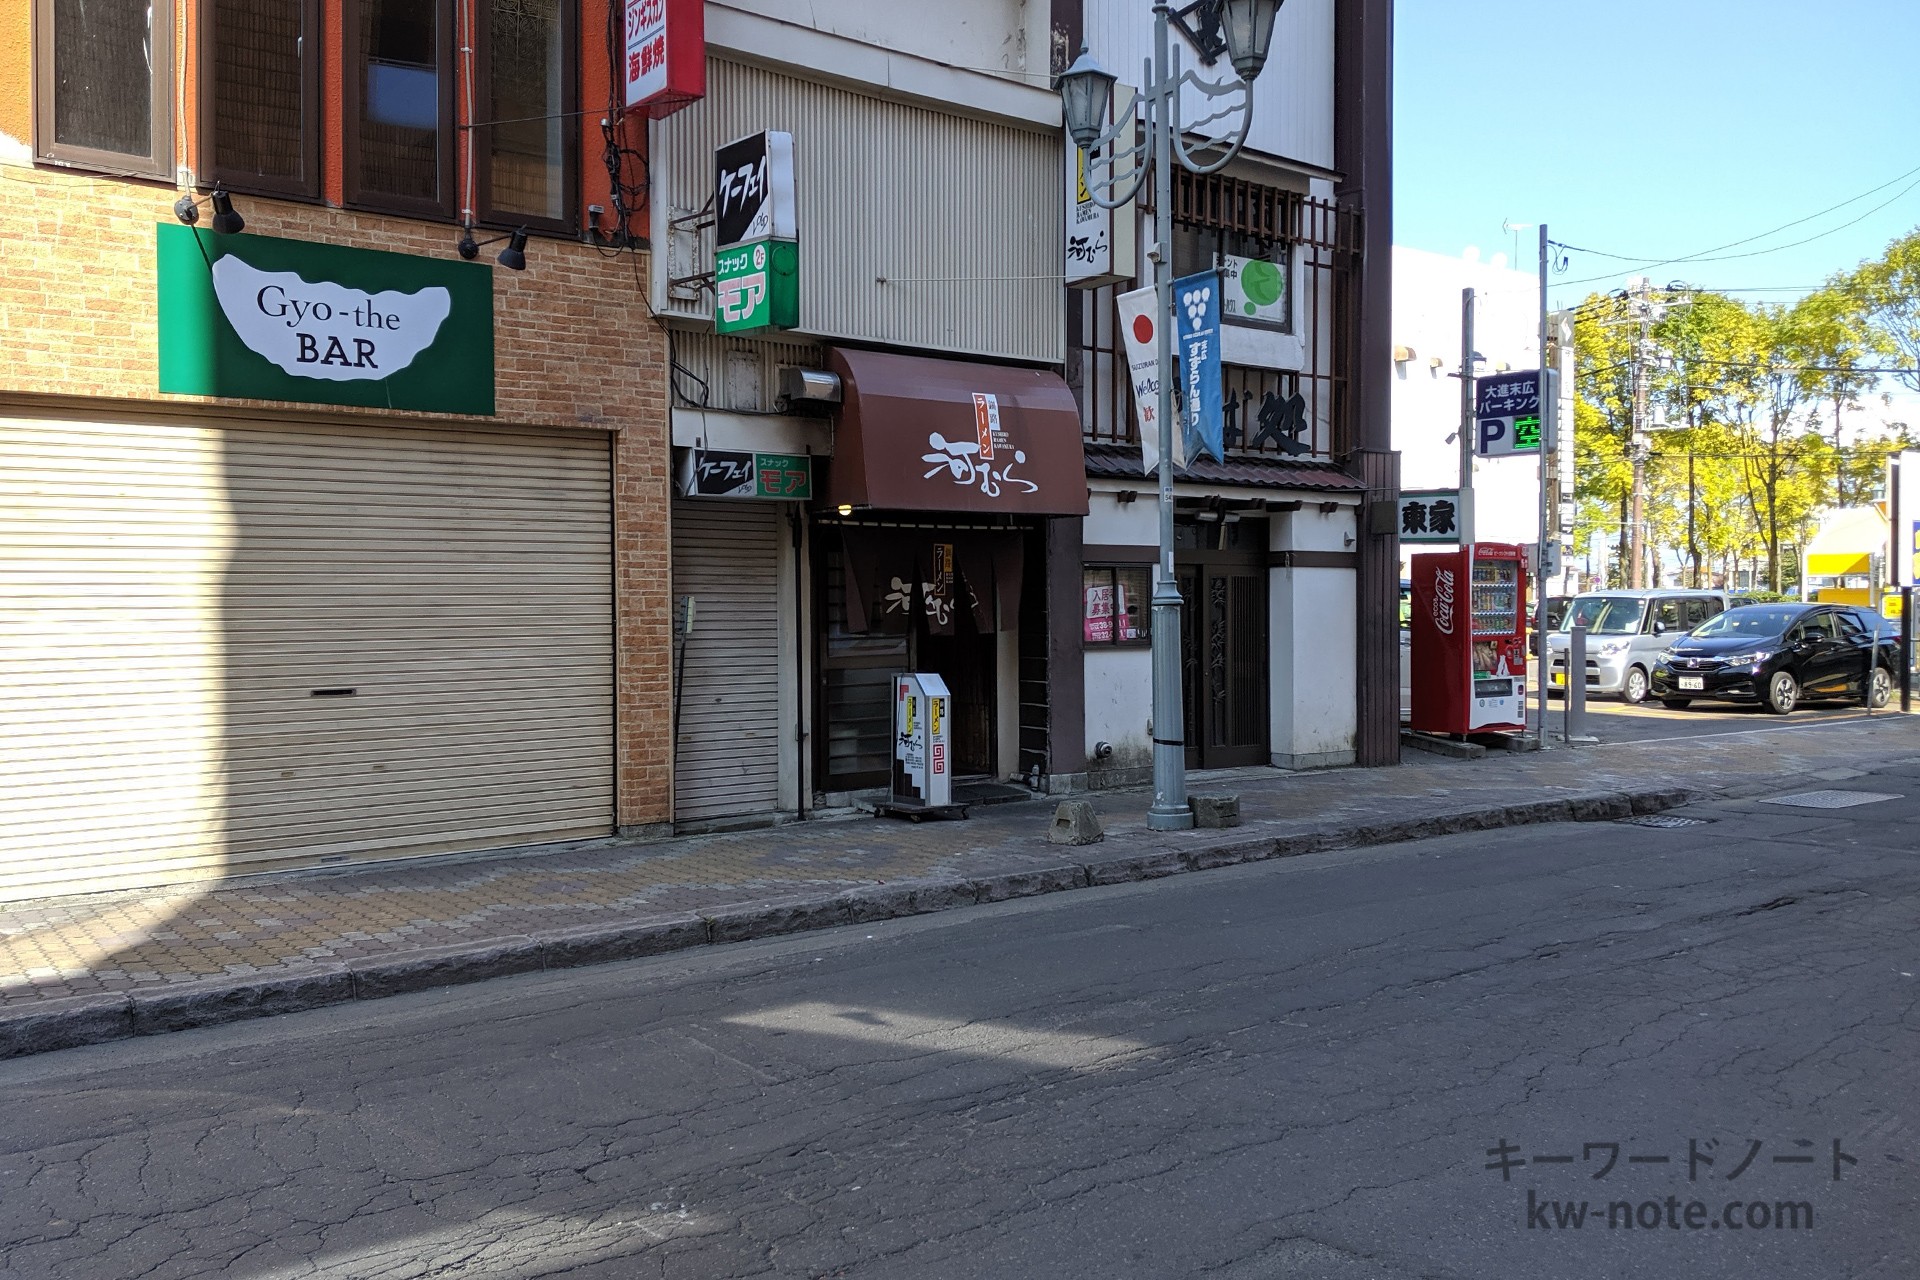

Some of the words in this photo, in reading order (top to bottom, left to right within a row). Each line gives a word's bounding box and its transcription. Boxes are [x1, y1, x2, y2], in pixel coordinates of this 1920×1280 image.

[628, 34, 665, 84] 海鮮焼
[718, 155, 767, 219] ケーフェイ
[718, 253, 748, 275] スナック
[755, 249, 765, 266] 2F
[256, 285, 401, 331] Gyo-the
[717, 271, 766, 323] モア
[295, 333, 379, 370] BAR
[1131, 360, 1155, 371] SUZURAN
[1188, 341, 1202, 427] すずらん通り
[1485, 381, 1536, 400] 大進末広
[976, 397, 991, 455] ラーメン
[1480, 418, 1506, 454] P
[1514, 416, 1540, 449] 空
[760, 458, 789, 468] スナック
[760, 469, 807, 494] モア
[1401, 499, 1456, 534] 東家
[936, 547, 944, 593] ラーメン
[1092, 602, 1113, 615] 募集
[1435, 566, 1454, 635] Coca-Cola
